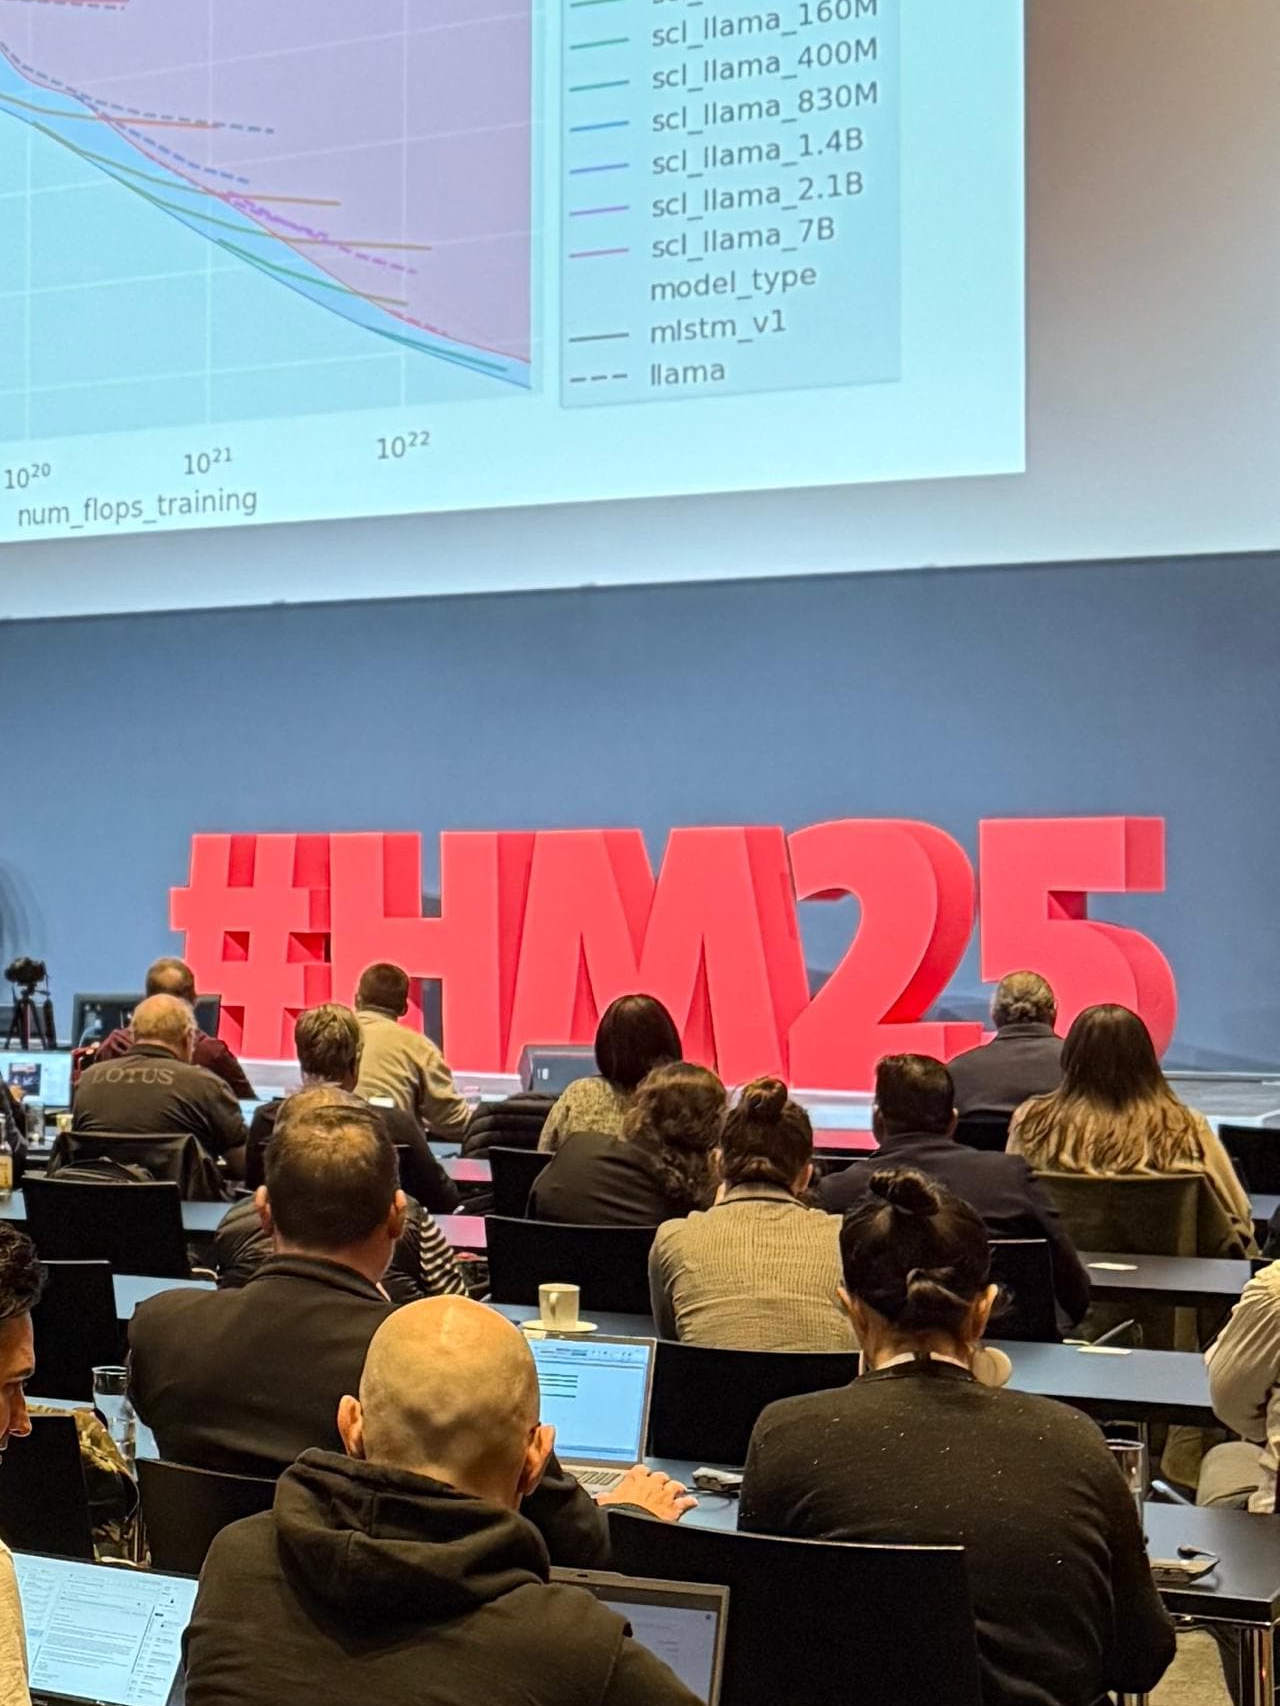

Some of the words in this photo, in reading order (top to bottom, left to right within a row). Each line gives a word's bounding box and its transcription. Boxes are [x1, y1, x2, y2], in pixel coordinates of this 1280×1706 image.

[652, 37, 878, 92] scl_llama_400M
[652, 81, 878, 135] scl_llama_830M
[652, 127, 864, 178] scl_llama_1.4B
[652, 171, 864, 221] scl_llama_2.1B
[652, 216, 835, 262] scl_llama_7B
[650, 267, 818, 301] model_type
[650, 309, 787, 344] mlstm_v1
[650, 363, 726, 386] llama
[18, 487, 258, 529] num_flops_training
[170, 816, 1177, 1092] #HM25
